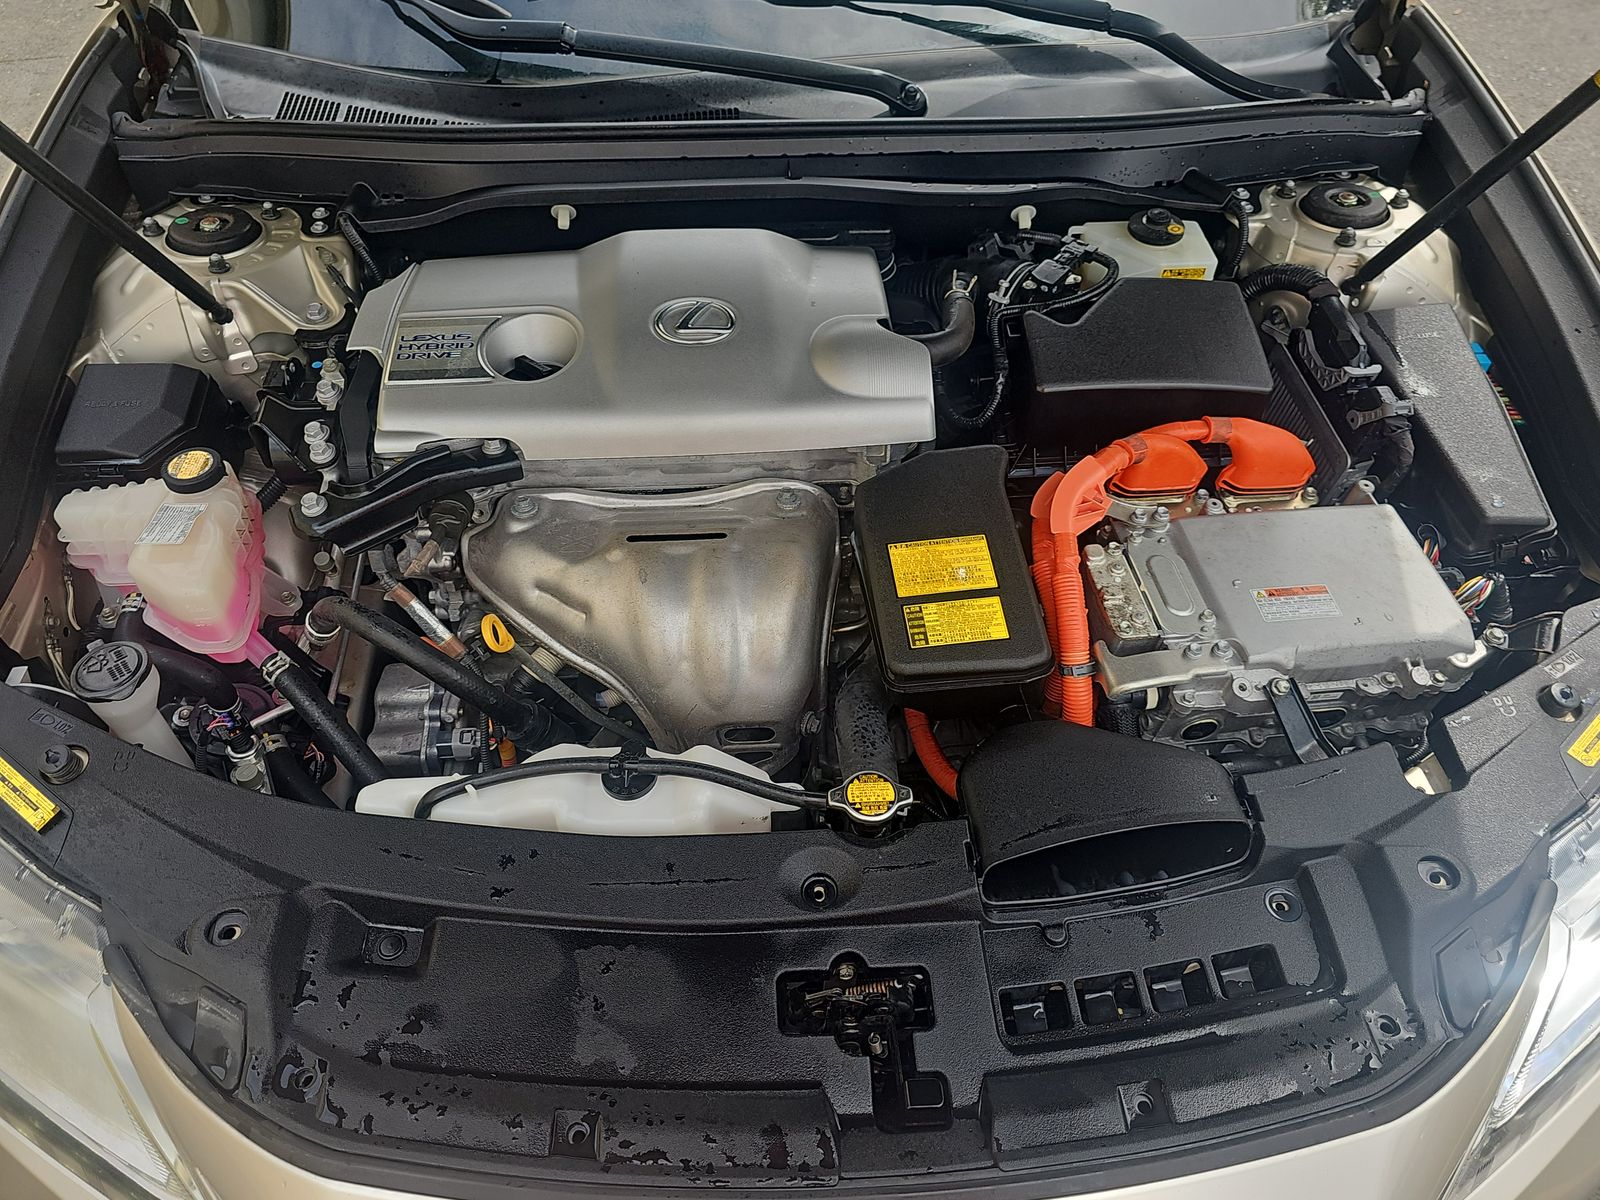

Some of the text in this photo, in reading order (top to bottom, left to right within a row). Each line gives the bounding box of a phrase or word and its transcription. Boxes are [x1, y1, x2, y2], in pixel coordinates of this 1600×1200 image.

[400, 333, 473, 342] LEXUS
[398, 342, 475, 351] HYBRID
[396, 352, 461, 360] DRIVE
